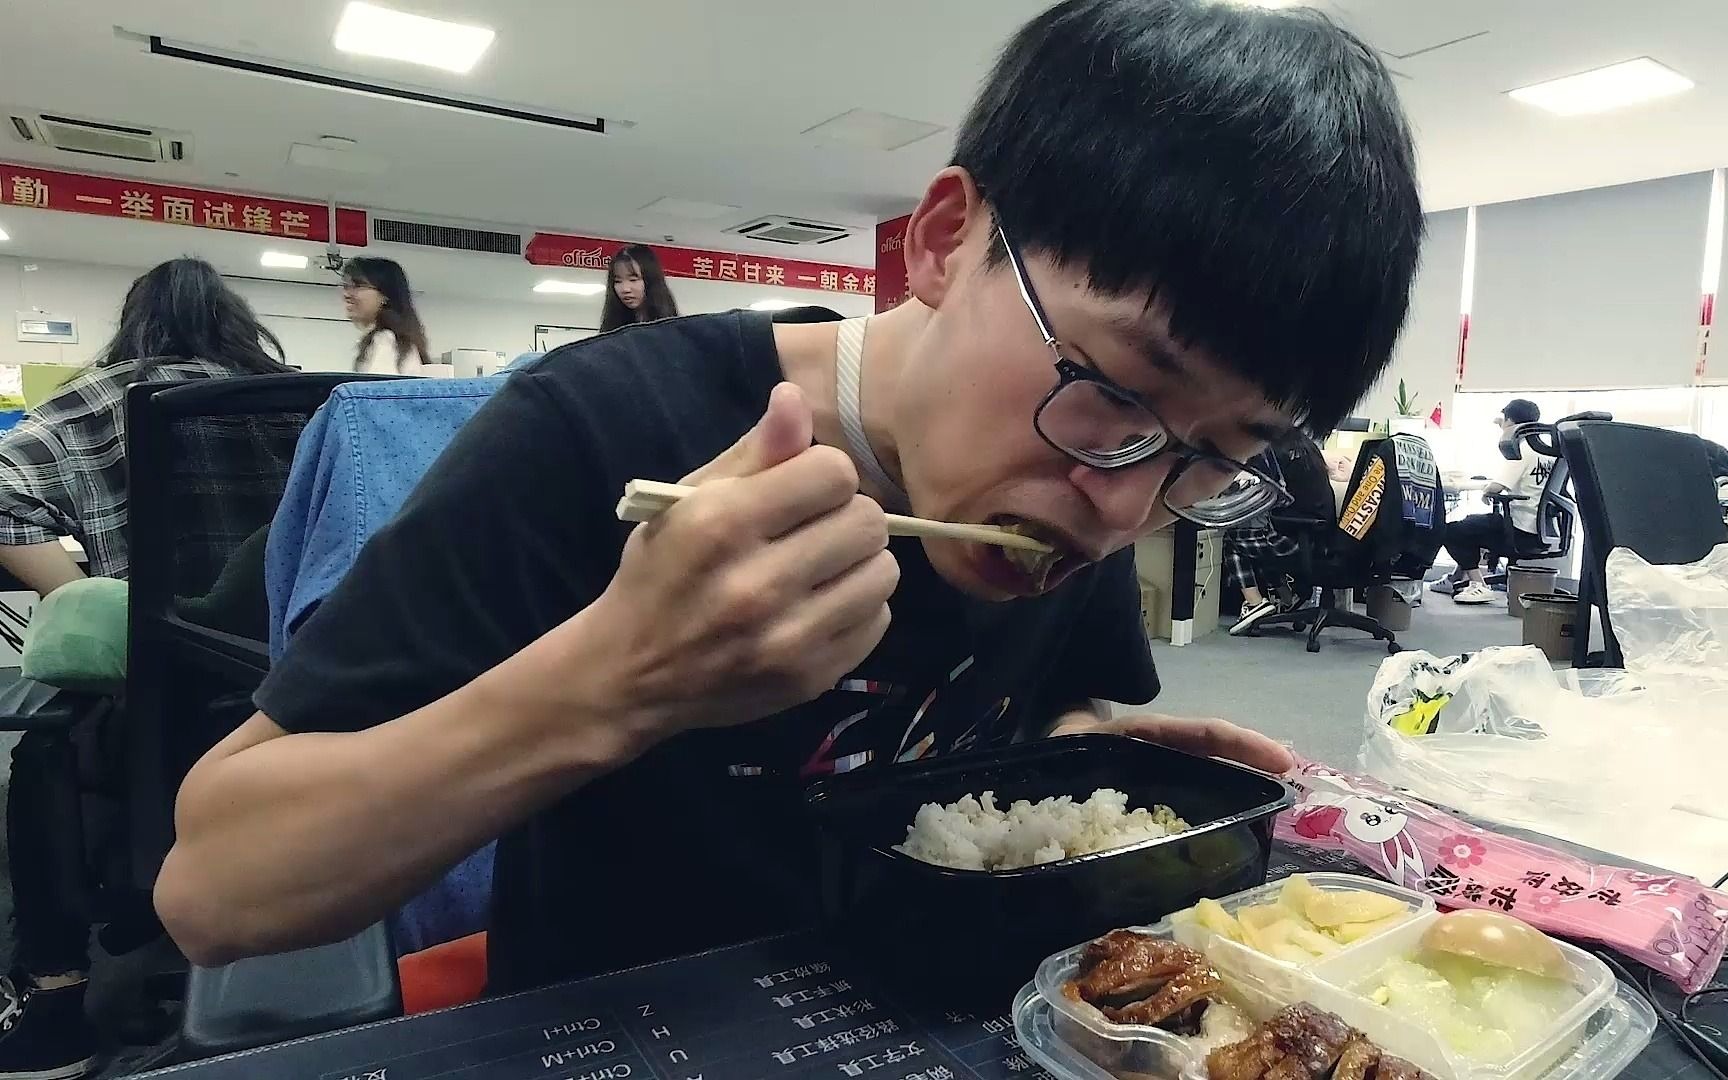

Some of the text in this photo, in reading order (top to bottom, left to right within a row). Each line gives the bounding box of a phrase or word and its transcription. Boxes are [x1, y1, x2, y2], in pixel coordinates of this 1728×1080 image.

[0, 175, 310, 238] 勤 一举面试锋芒
[692, 256, 786, 286] 苦尽甘来
[771, 979, 852, 1008] 抓手工具
[638, 1004, 655, 1017] Z
[791, 999, 877, 1029] 形状工具
[651, 1025, 671, 1040] H
[770, 1019, 900, 1065] 路径选择工具
[541, 1040, 616, 1068] Ctrl+M
[669, 1049, 689, 1064] U
[836, 1041, 925, 1077] 文字工具
[564, 1064, 632, 1080] Ctrl+
